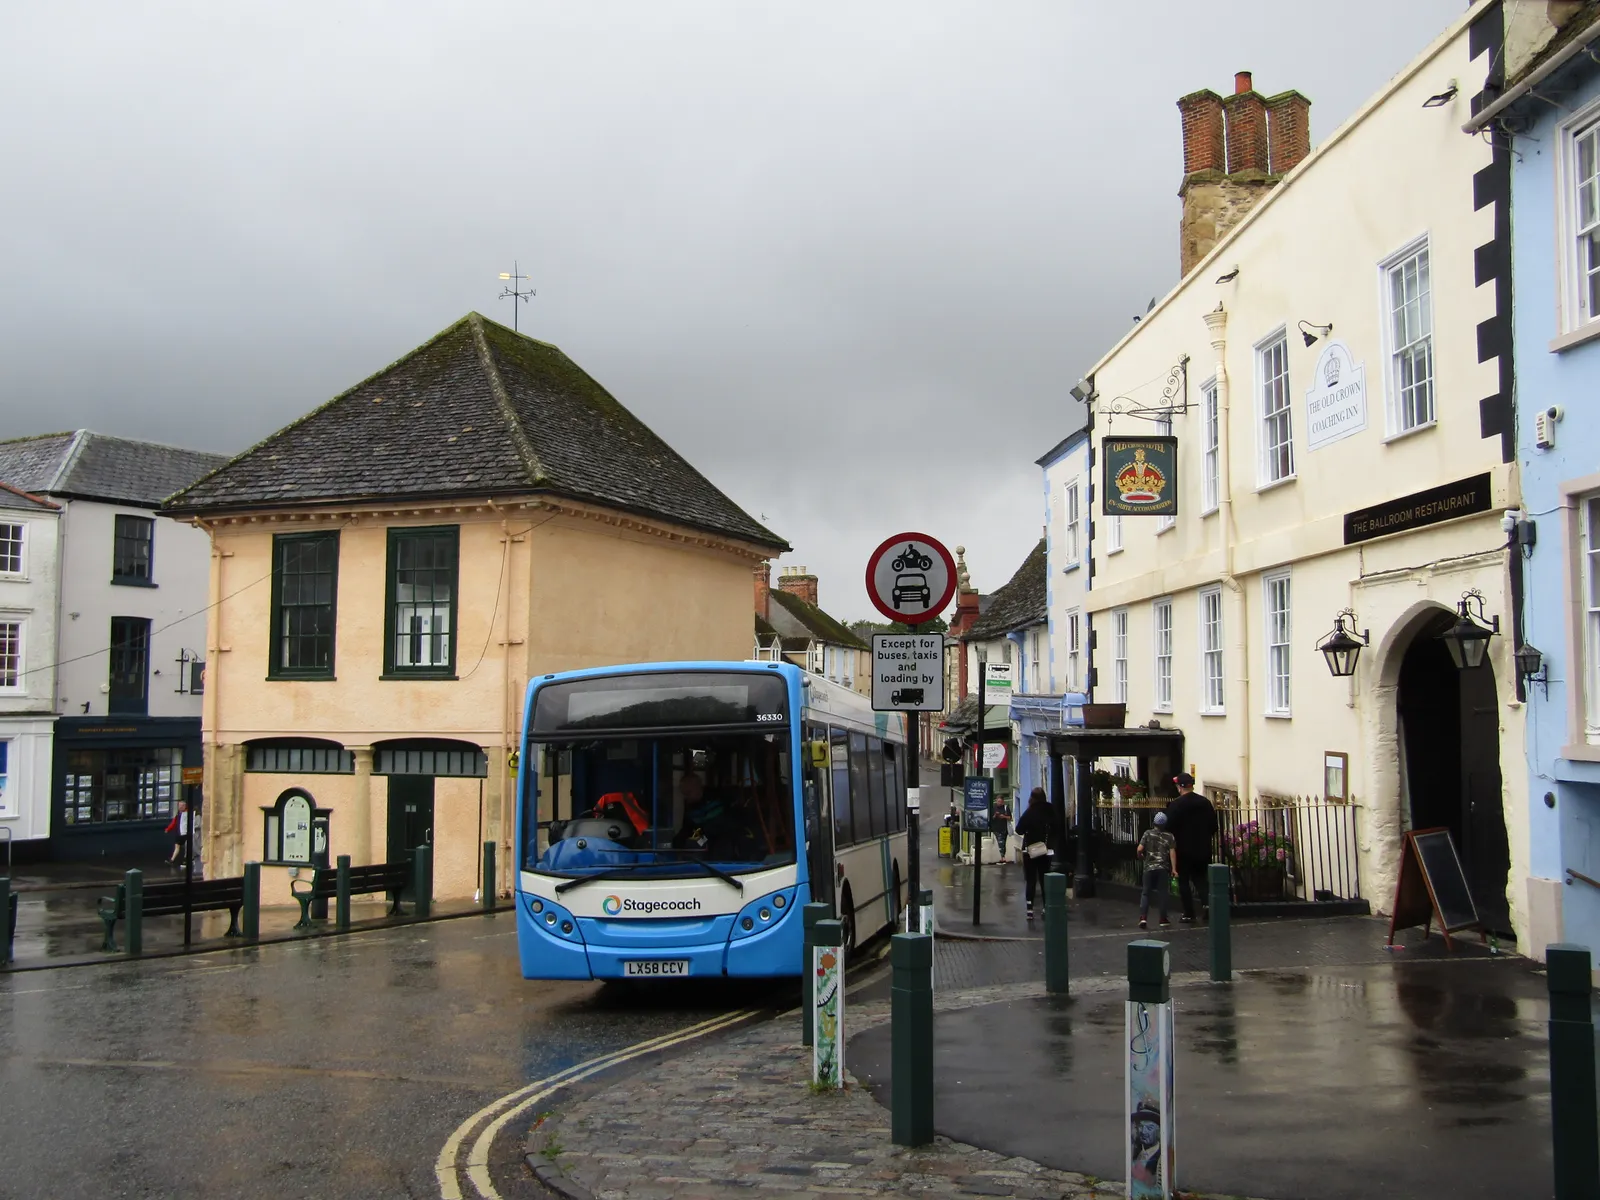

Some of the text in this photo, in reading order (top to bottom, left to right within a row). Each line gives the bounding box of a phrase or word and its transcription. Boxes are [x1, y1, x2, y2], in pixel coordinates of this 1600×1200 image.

[1309, 380, 1361, 415] THE OLD CROWN
[1312, 403, 1359, 434] COACHING INN
[1113, 442, 1127, 452] OLD
[1145, 442, 1166, 454] HOTEL
[1352, 491, 1476, 535] THE BALLROOM RESTAURANT
[881, 639, 935, 650] Except for
[912, 651, 938, 660] taxis
[897, 662, 917, 671] and
[881, 674, 935, 685] loading by
[756, 713, 783, 722] 36330
[623, 897, 701, 913] Stagecoach
[628, 961, 684, 975] LX58 CCV
